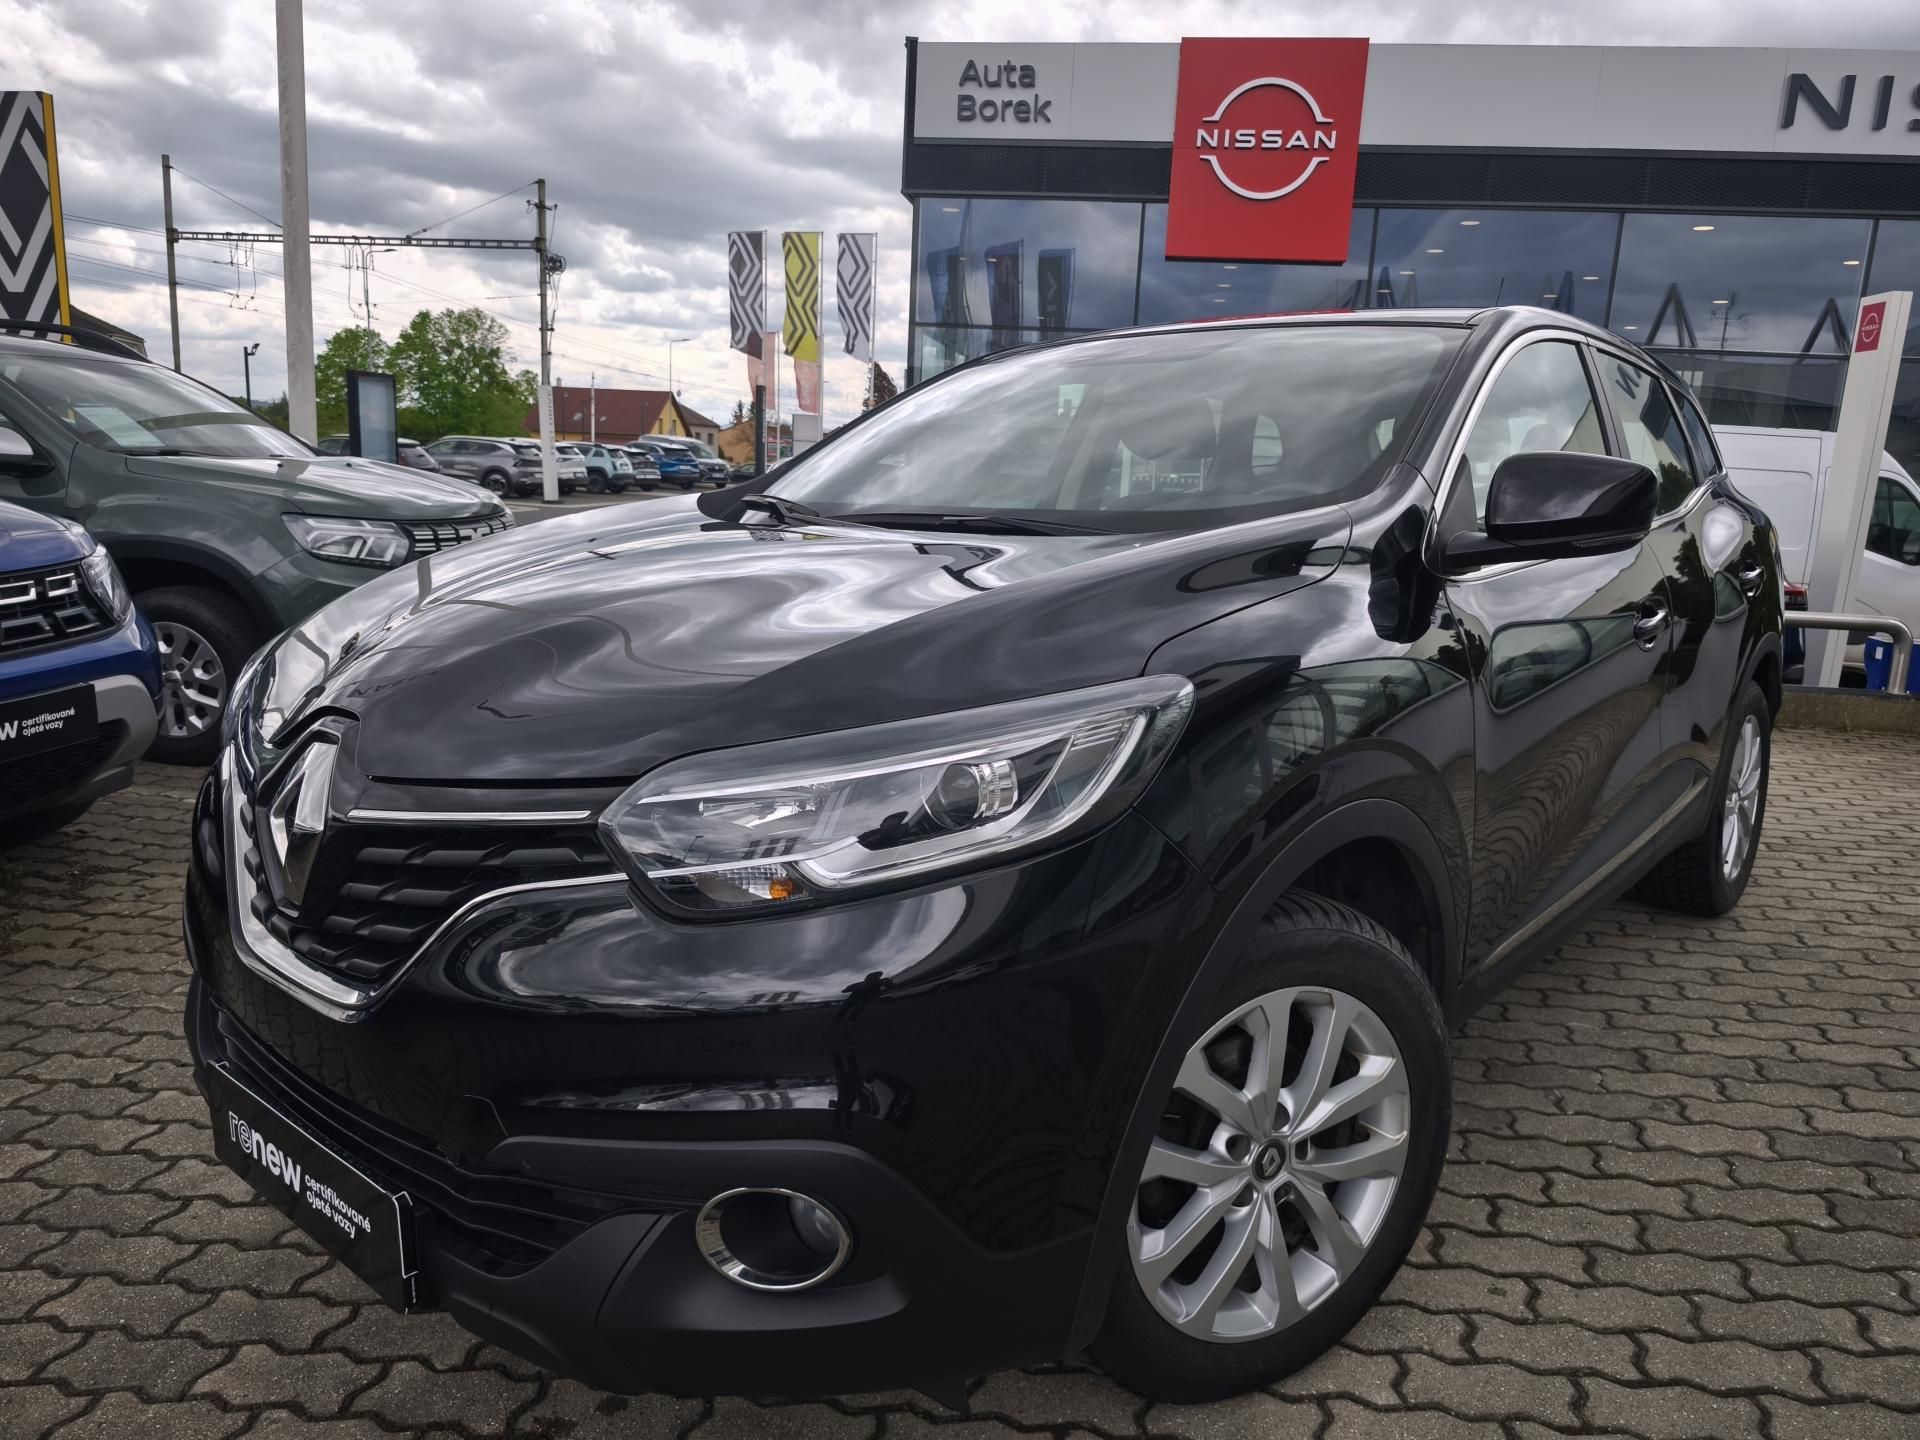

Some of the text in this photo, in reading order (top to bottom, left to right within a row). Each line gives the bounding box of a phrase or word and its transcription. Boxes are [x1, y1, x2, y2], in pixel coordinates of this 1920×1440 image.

[959, 59, 1035, 88] Auta
[957, 93, 1052, 123] Borek
[1780, 73, 1920, 131] NI
[1196, 128, 1337, 150] NISSAN
[1861, 323, 1880, 331] NISSAN
[22, 706, 75, 727] certifikované
[22, 720, 63, 736] ojeté vozy
[228, 1110, 301, 1193] renew
[304, 1174, 371, 1232] certifikované
[306, 1190, 355, 1239] ojeté vozy
